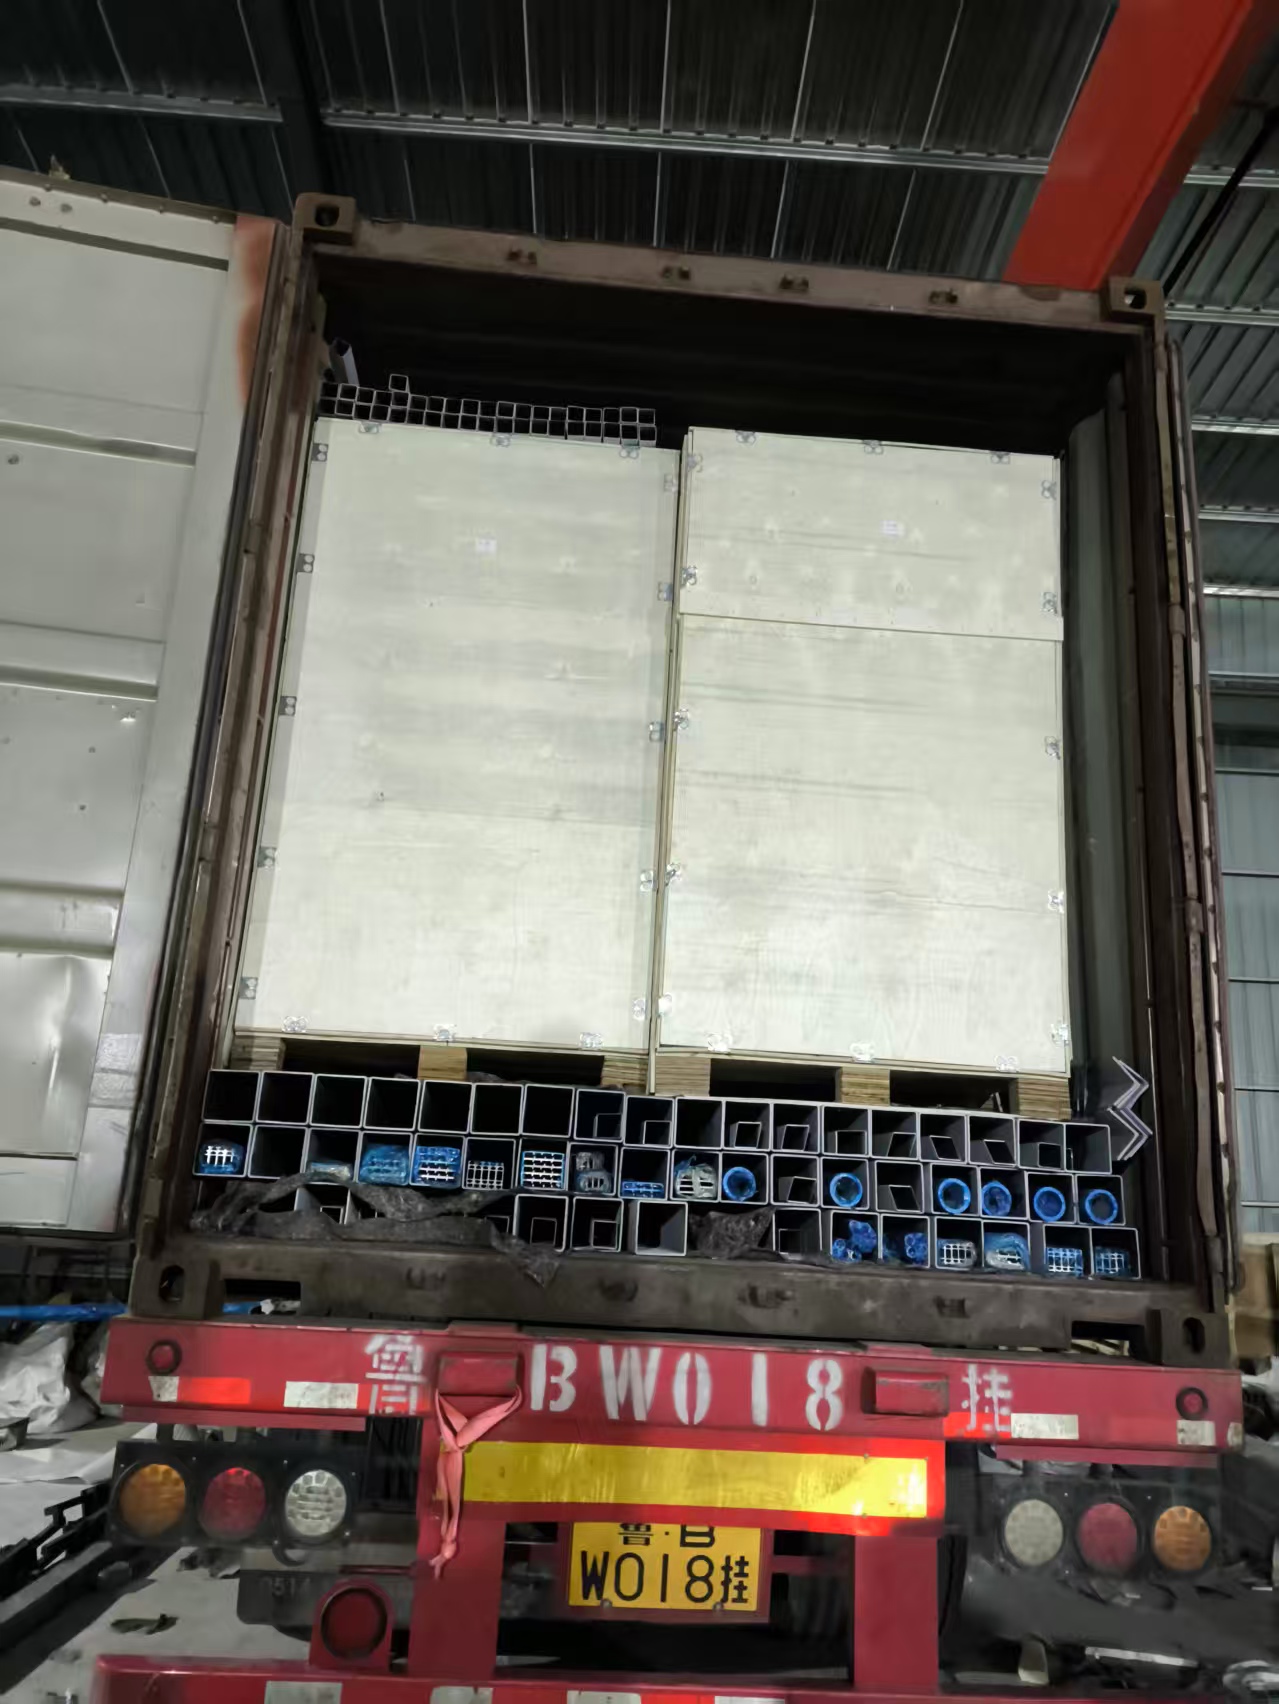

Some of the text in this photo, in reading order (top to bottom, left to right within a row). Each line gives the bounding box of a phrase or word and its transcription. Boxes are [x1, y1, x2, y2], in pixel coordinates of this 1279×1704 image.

[365, 1334, 426, 1415] 鲁
[961, 1363, 1013, 1433] 挂
[581, 1550, 749, 1603] W018挂
